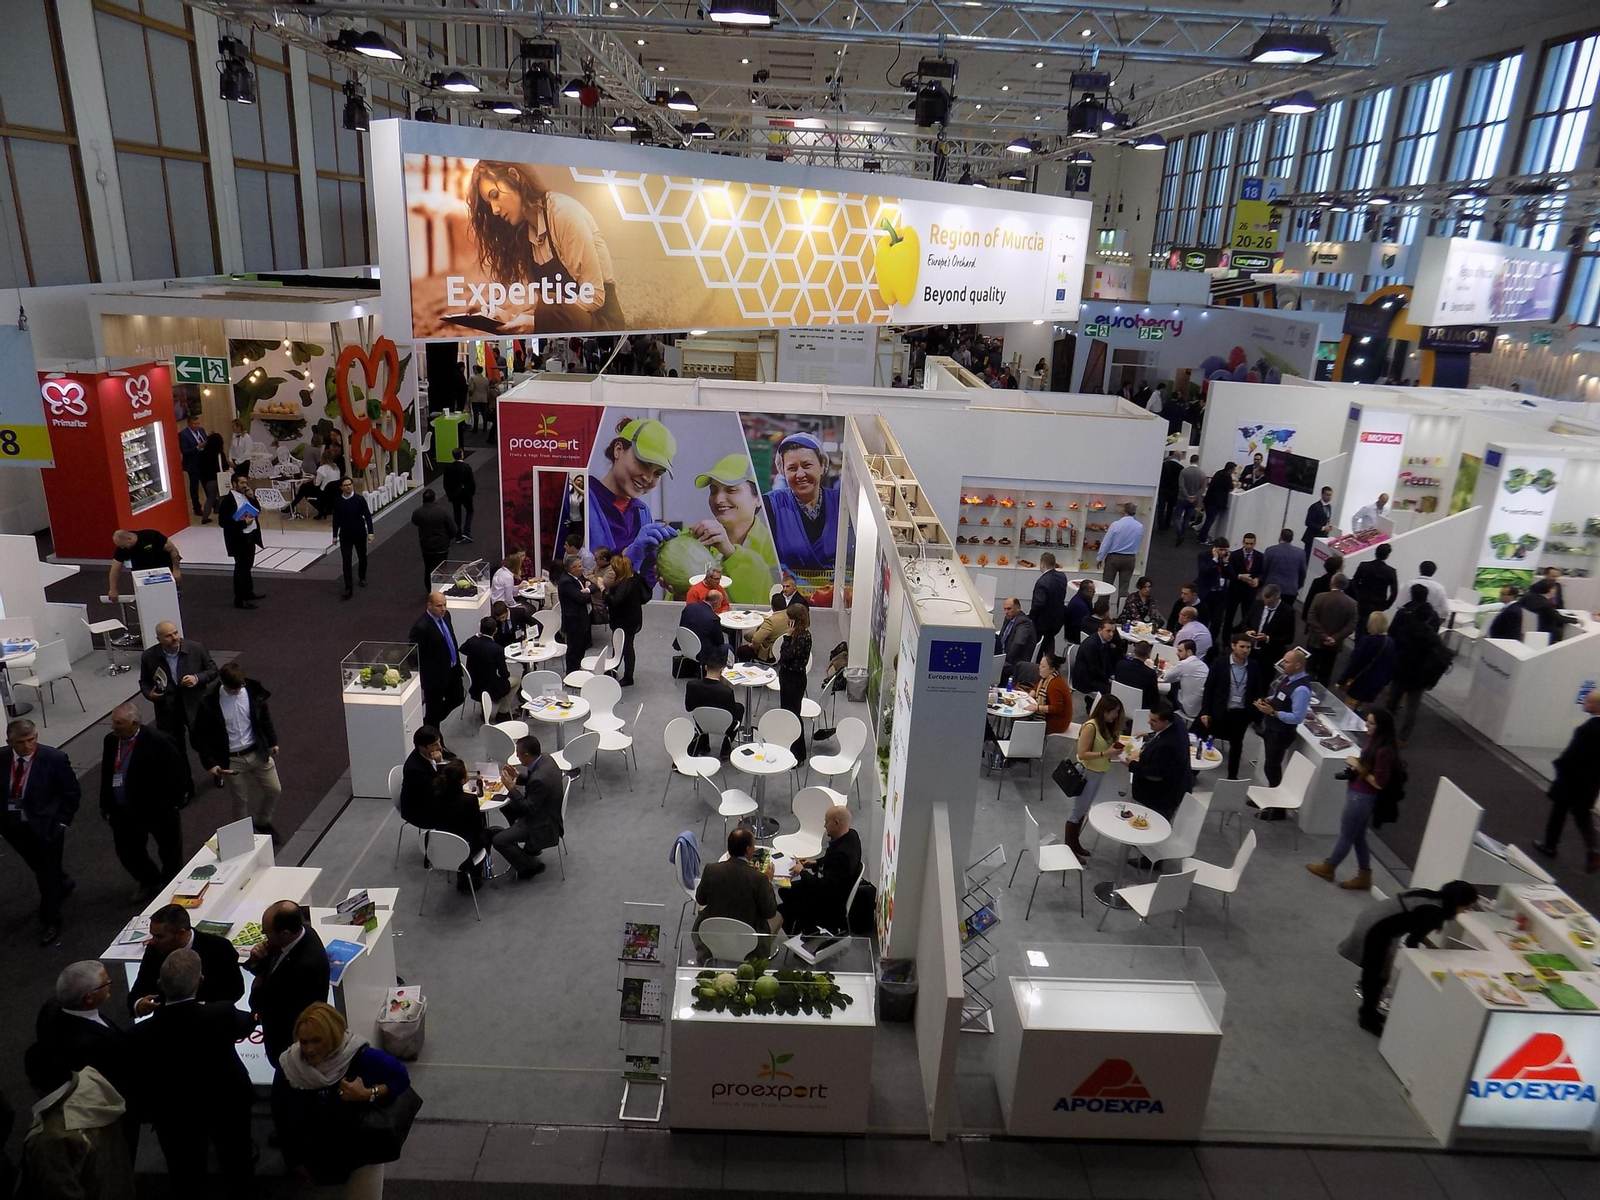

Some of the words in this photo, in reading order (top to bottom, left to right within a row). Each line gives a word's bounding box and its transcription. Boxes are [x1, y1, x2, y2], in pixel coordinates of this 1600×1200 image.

[1244, 187, 1259, 198] 18
[929, 223, 980, 251] Region
[983, 227, 1000, 248] of
[1002, 229, 1044, 252] Murcia
[1236, 235, 1273, 249] 20-26
[927, 253, 951, 270] Europe's
[446, 273, 595, 313] Expertise
[924, 285, 967, 306] Beyond
[969, 286, 1006, 306] quality
[1095, 314, 1183, 337] euroberry
[1427, 327, 1488, 343] PRIMOR
[52, 419, 88, 428] Primaflor
[509, 438, 579, 452] proexport
[1367, 434, 1400, 443] MOYCA
[928, 673, 958, 681] European
[711, 1083, 828, 1102] proexport
[1467, 1080, 1597, 1102] APOEXPA
[1053, 1097, 1164, 1114] APOEXPA
